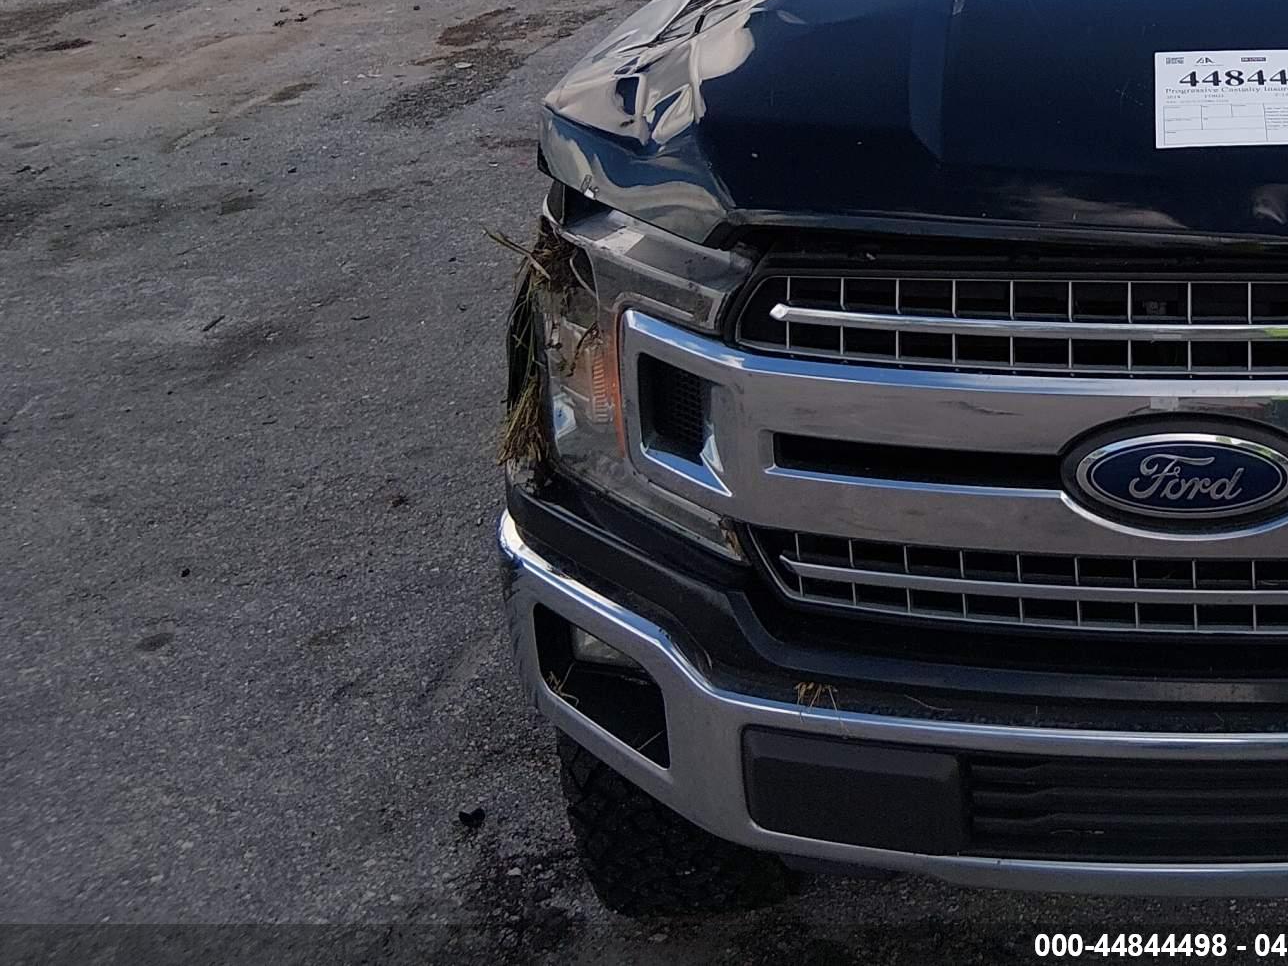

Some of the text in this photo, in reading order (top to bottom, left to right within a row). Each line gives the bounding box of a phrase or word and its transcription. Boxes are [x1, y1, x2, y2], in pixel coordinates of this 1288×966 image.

[1165, 87, 1218, 95] Progressive
[1221, 86, 1260, 94] Casualty
[1129, 453, 1245, 500] Ford
